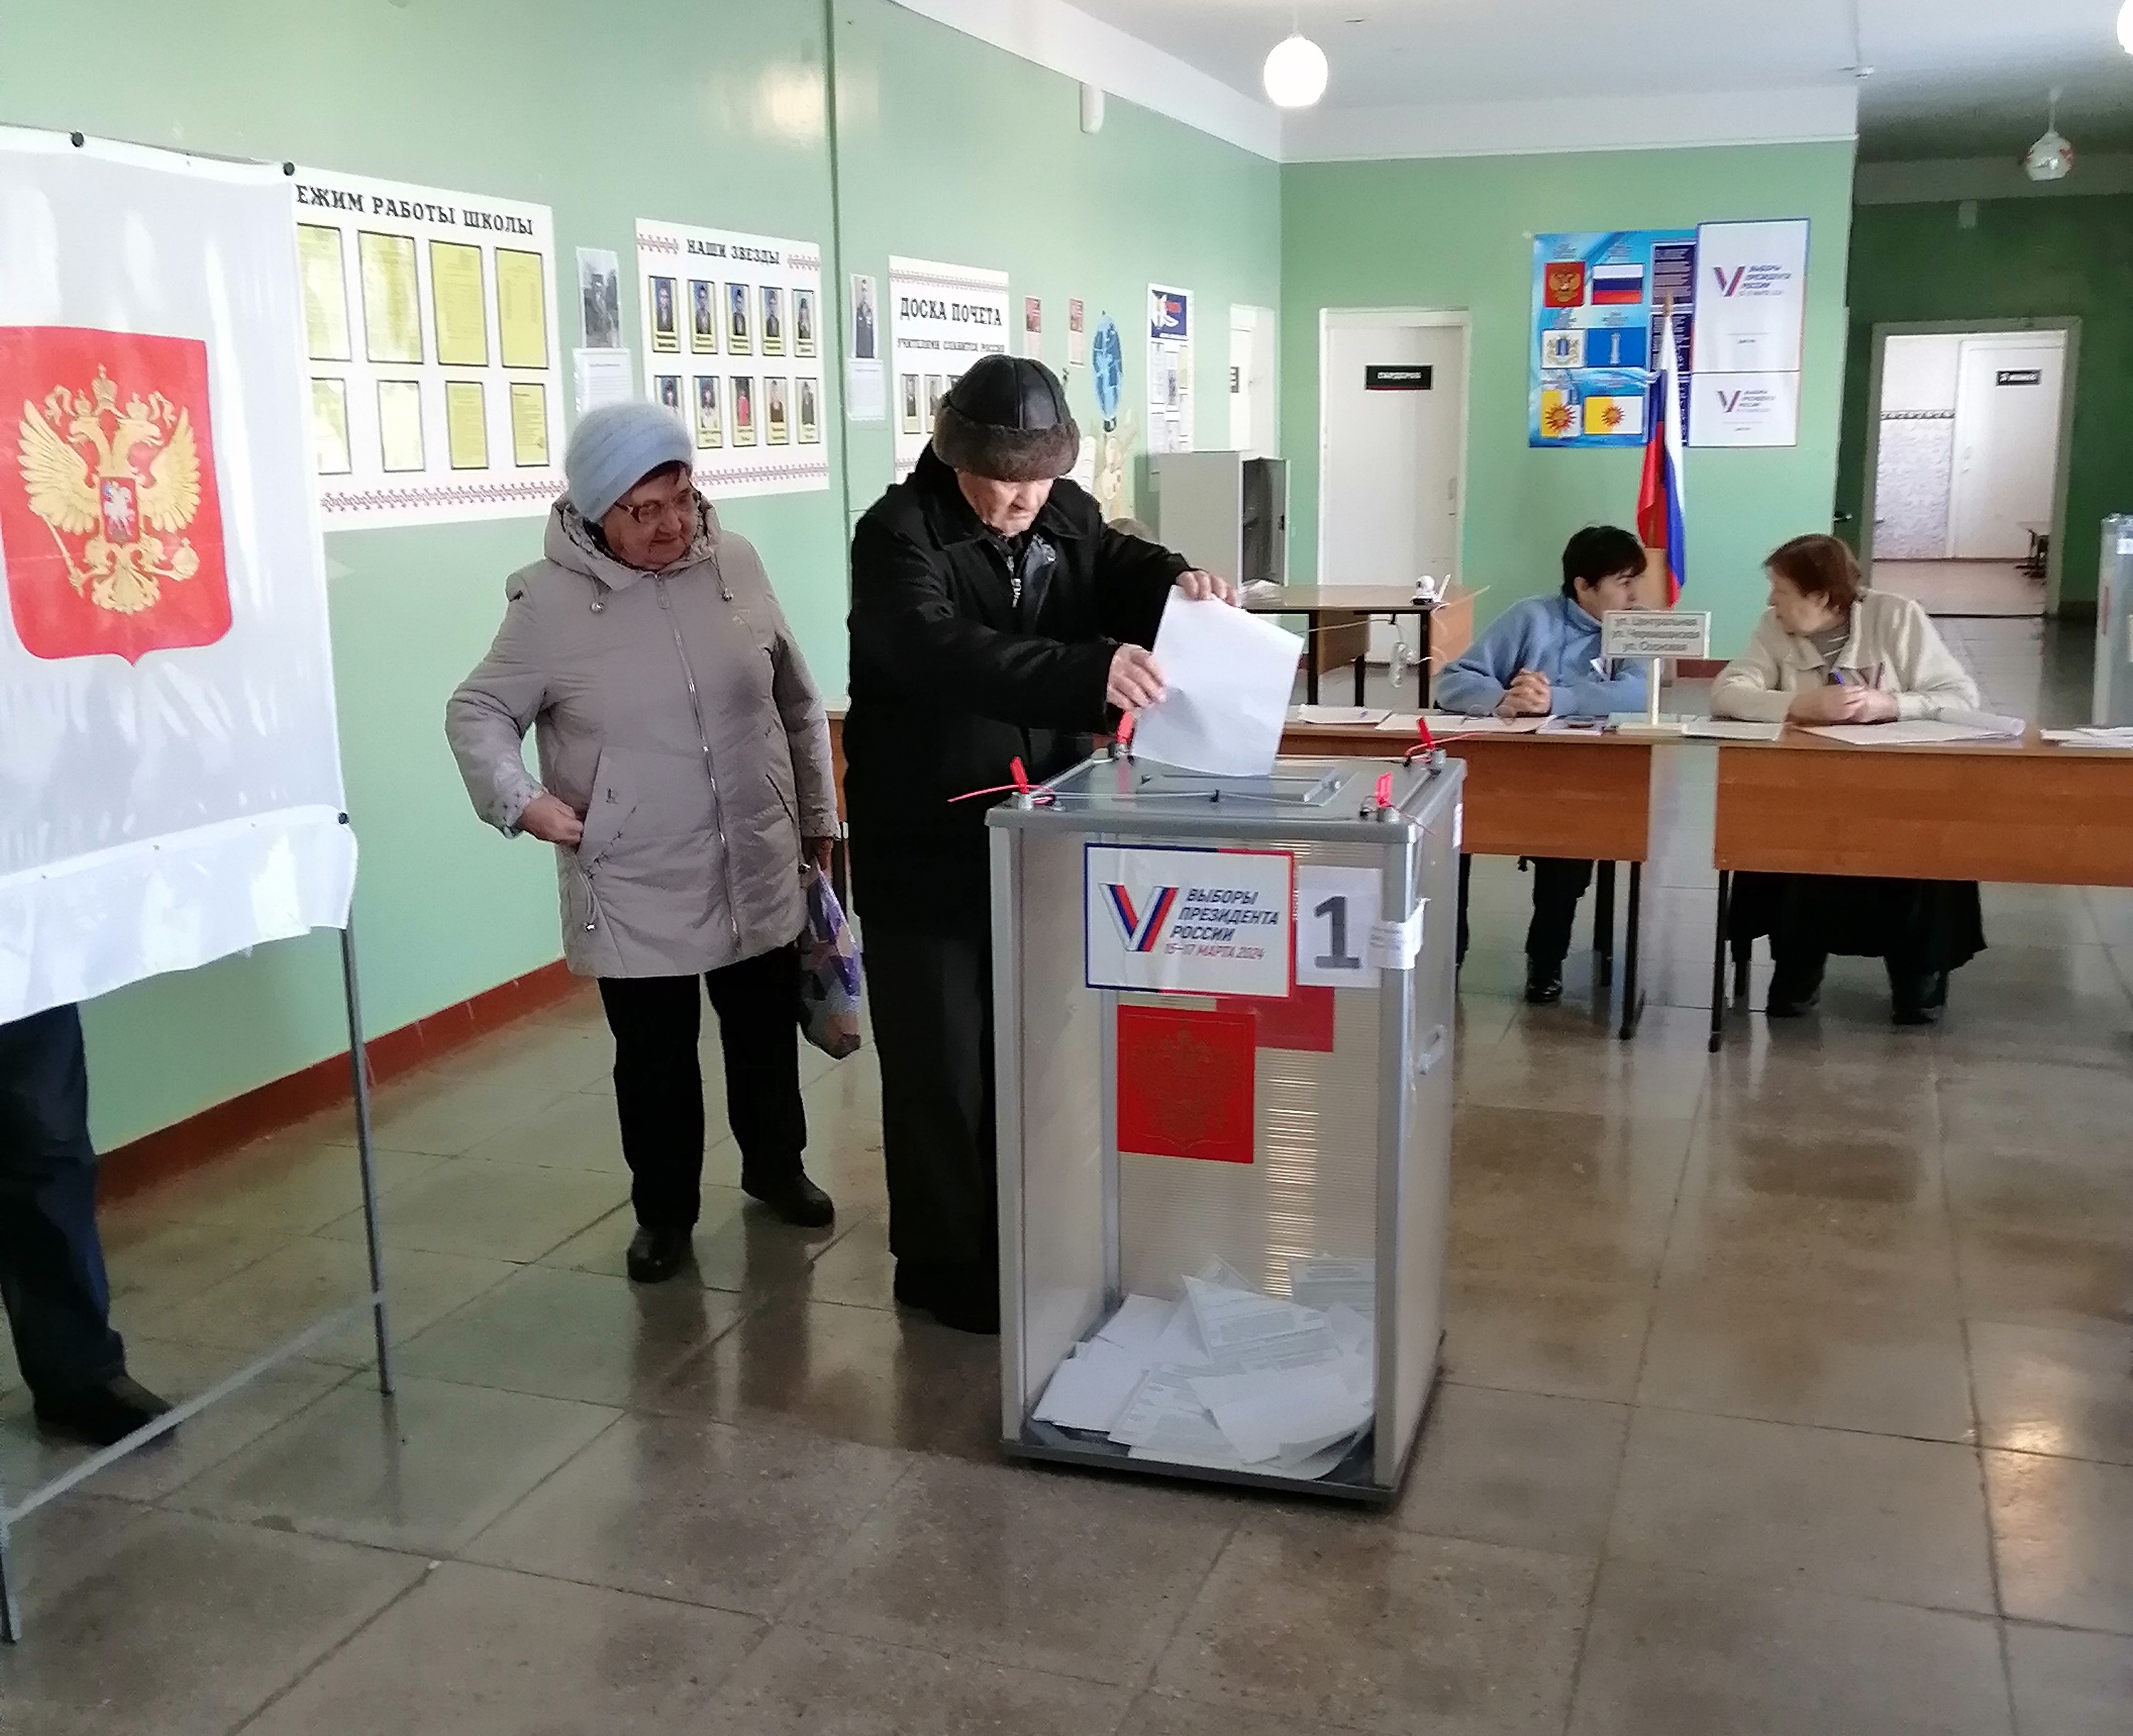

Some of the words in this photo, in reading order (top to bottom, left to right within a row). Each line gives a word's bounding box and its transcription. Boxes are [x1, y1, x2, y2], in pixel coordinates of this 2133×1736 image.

[295, 184, 364, 212] ЕЖИМ
[371, 196, 455, 224] РАБОТЫ
[462, 209, 534, 236] ШКОЛЫ
[687, 239, 727, 258] НАШИ
[731, 246, 781, 266] ЗВЕЗДЫ
[900, 297, 947, 320] ДОСКА
[952, 302, 1002, 326] ПОЧЕТА
[1185, 887, 1259, 905] ВЫБОРЫ
[1178, 906, 1280, 925] ПРЕЗИДЕНТА
[1170, 925, 1236, 941] РОССИИ
[1314, 895, 1360, 968] 1
[1196, 943, 1234, 958] МАРТА
[1235, 945, 1265, 960] 2024
